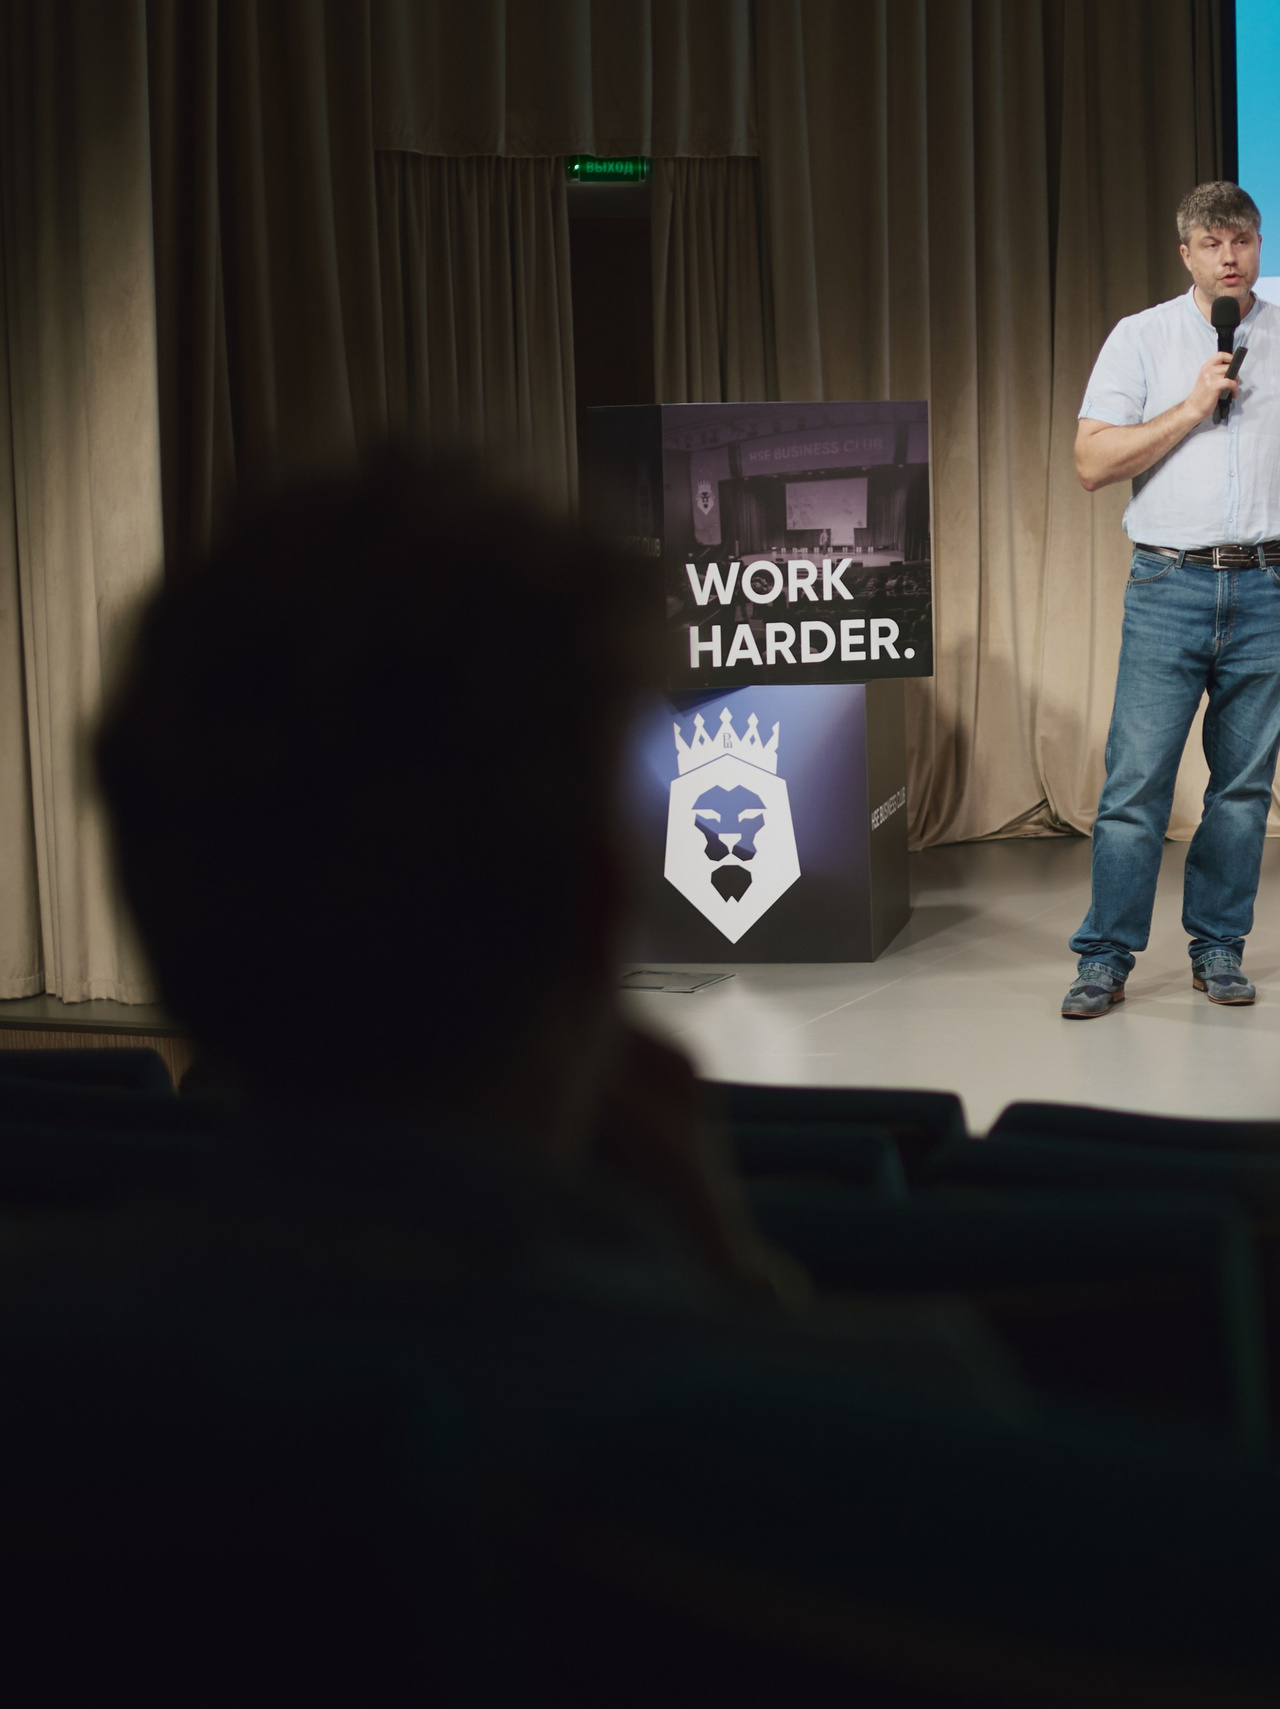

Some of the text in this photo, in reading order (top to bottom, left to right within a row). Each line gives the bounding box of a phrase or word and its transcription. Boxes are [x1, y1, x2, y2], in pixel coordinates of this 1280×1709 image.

[585, 161, 634, 175] ВЫХОД
[773, 441, 840, 460] BUSINESS
[685, 558, 855, 606] WORK
[688, 618, 916, 669] HARDER.
